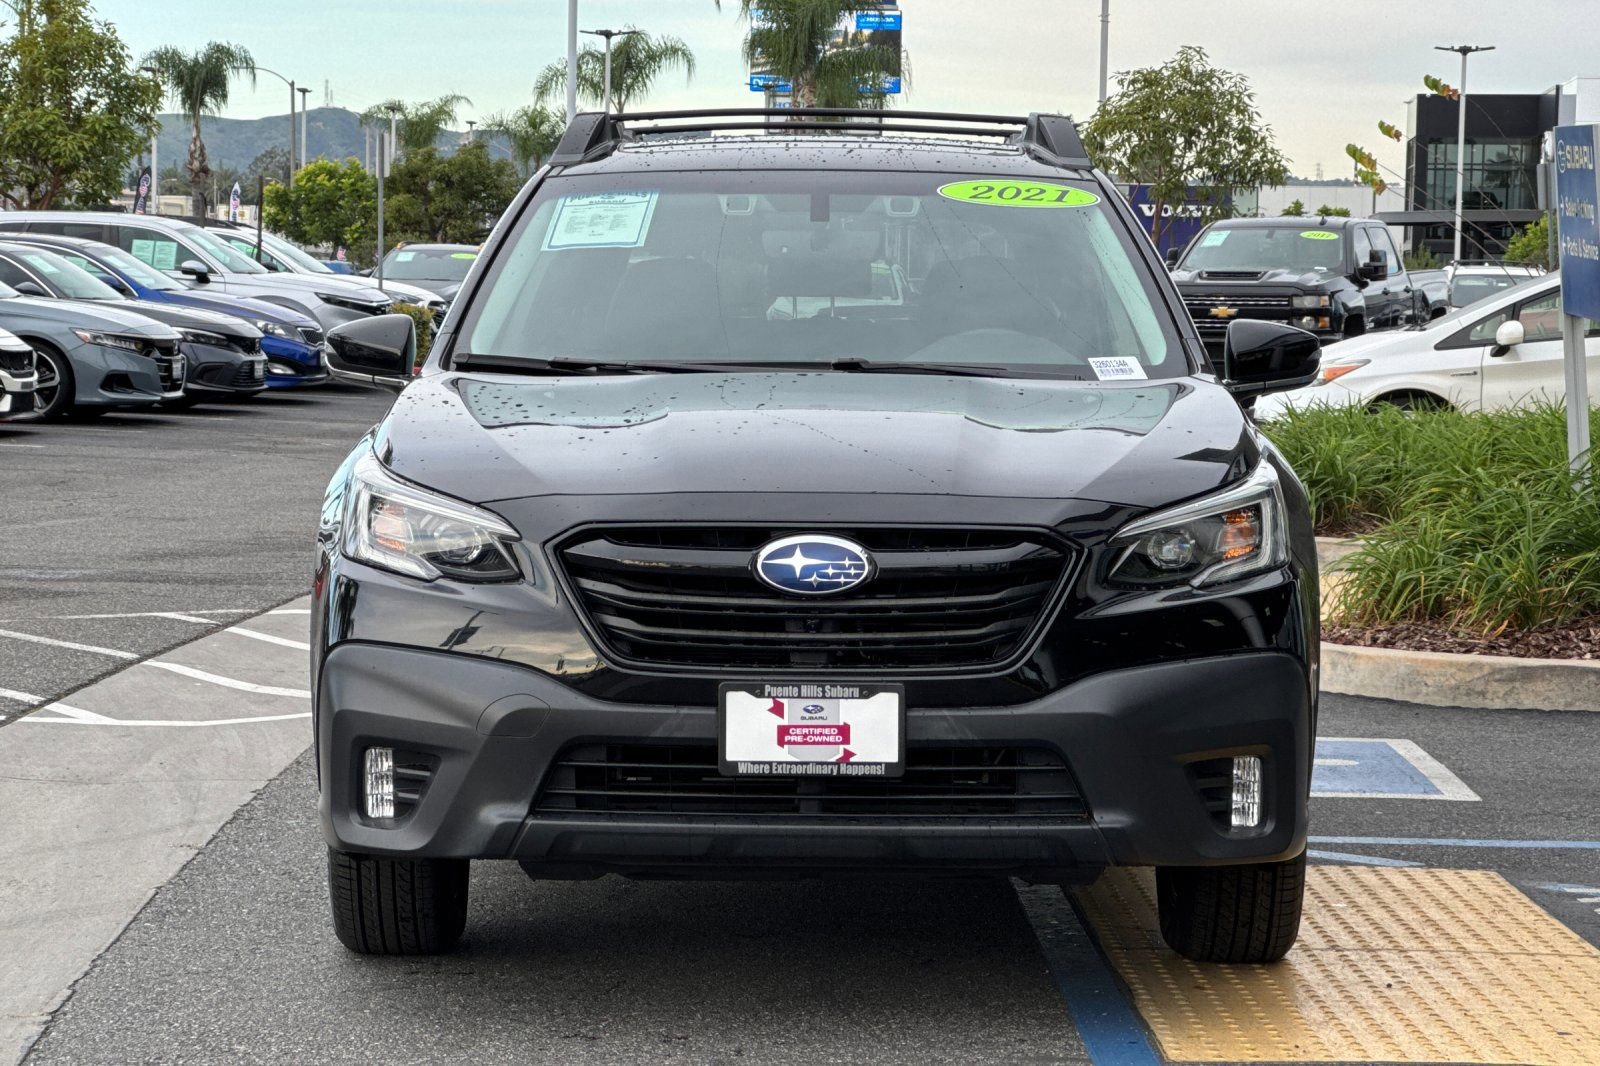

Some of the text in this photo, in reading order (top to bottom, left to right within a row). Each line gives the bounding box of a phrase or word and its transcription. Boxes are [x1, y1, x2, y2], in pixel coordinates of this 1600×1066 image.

[1565, 145, 1593, 169] SUBARU
[968, 185, 1071, 203] 2021
[1583, 238, 1599, 261] Service
[764, 684, 860, 698] Puente Hills Subaru
[789, 727, 838, 735] CERTIFIED
[738, 762, 886, 776] Where Extraordinary Happens!
